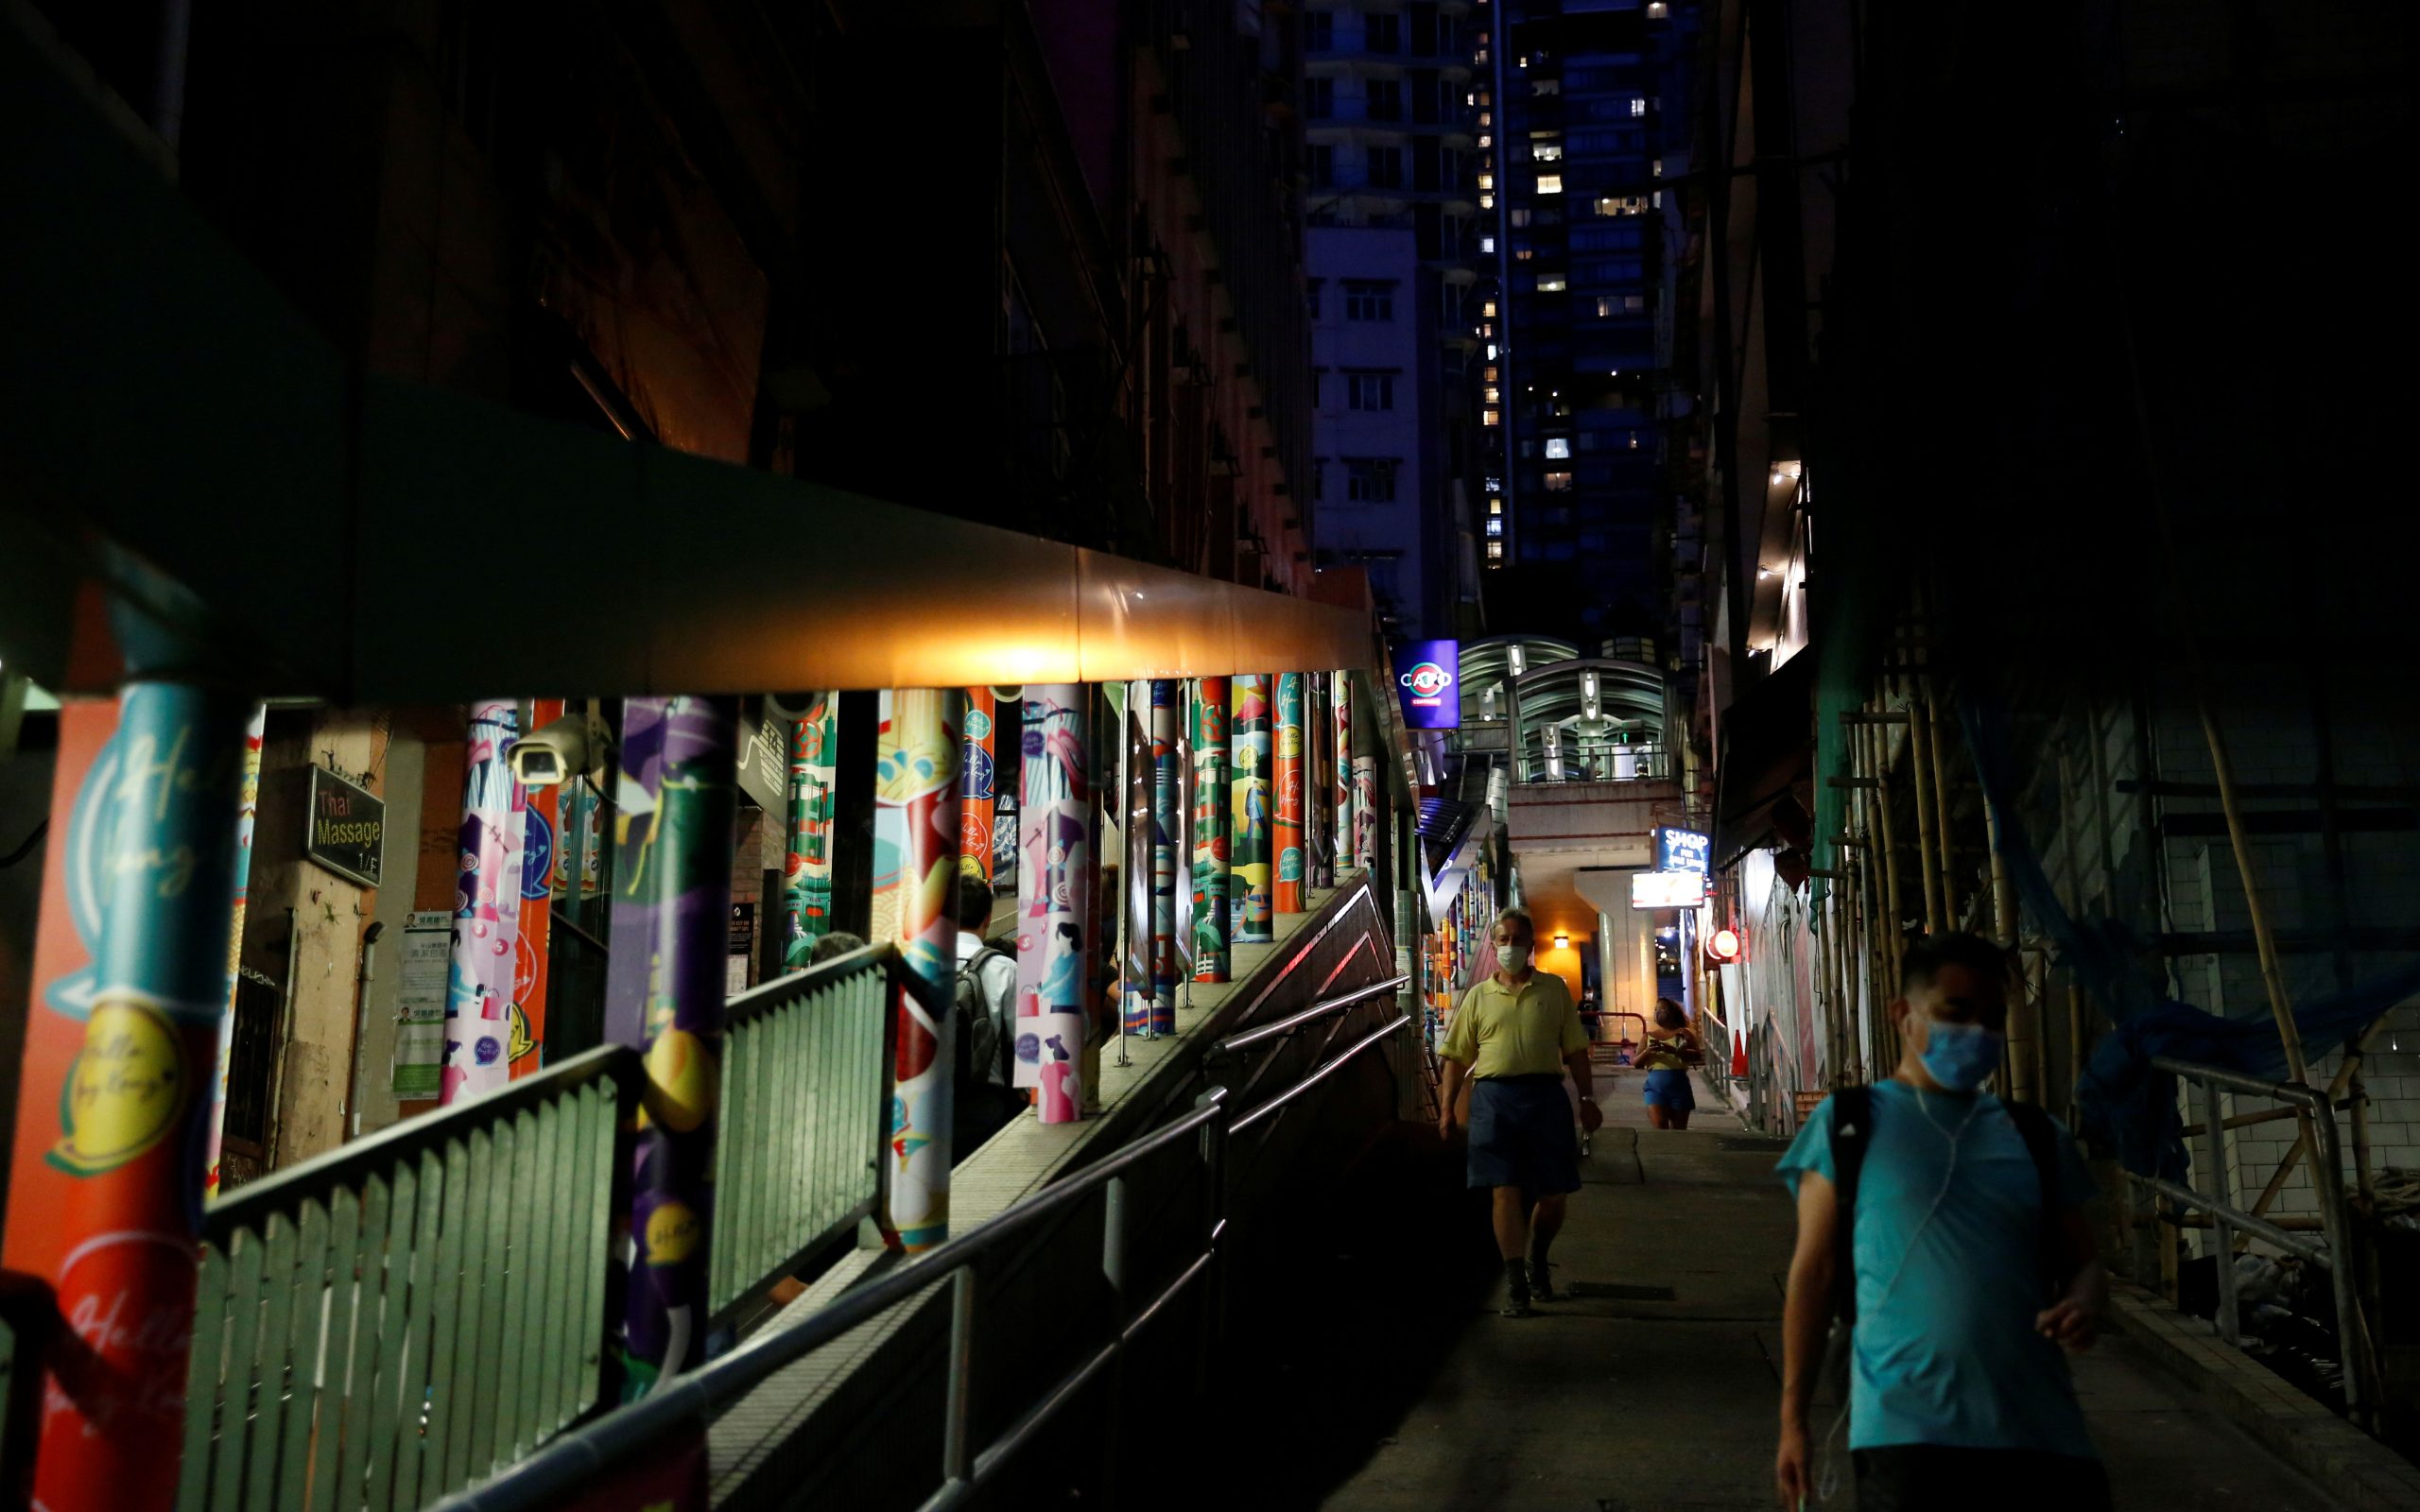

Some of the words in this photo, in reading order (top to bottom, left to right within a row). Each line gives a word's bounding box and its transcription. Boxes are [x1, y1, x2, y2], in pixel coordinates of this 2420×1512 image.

[318, 791, 351, 816] Thai
[318, 818, 380, 848] Massage
[1666, 830, 1708, 850] SHOP
[358, 852, 378, 874] 1/F
